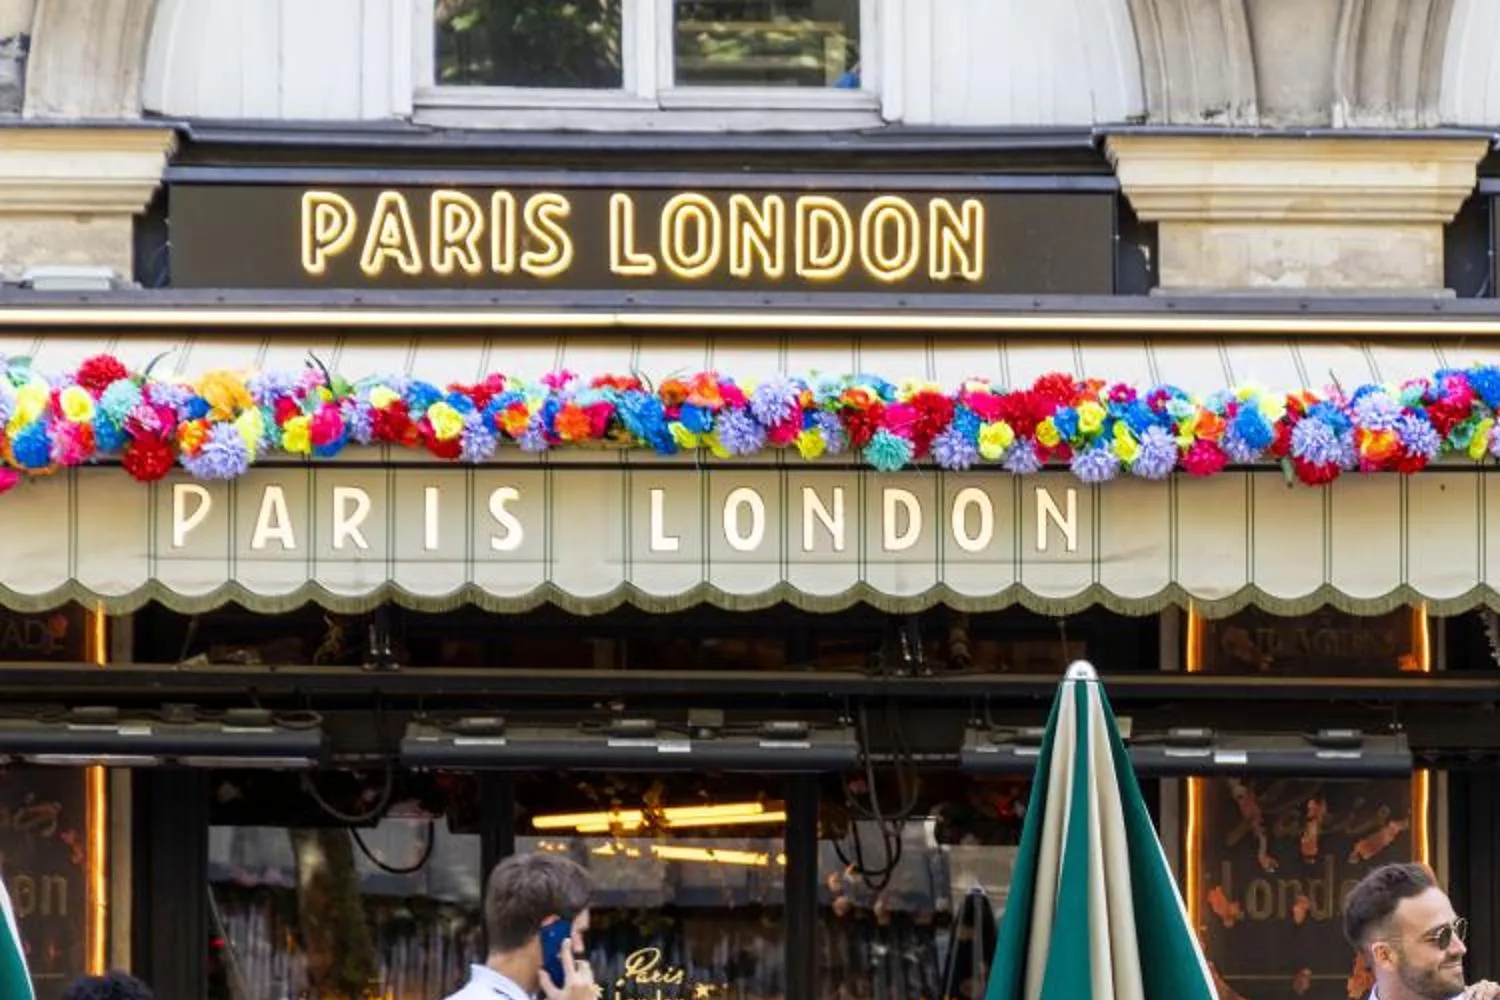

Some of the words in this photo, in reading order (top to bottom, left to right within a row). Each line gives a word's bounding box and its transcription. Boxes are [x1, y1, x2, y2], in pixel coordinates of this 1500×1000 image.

[301, 190, 574, 278] PARIS
[609, 192, 987, 282] LONDON
[172, 483, 524, 552] PARIS
[649, 486, 1079, 552] LONDON
[615, 946, 685, 987] Paris
